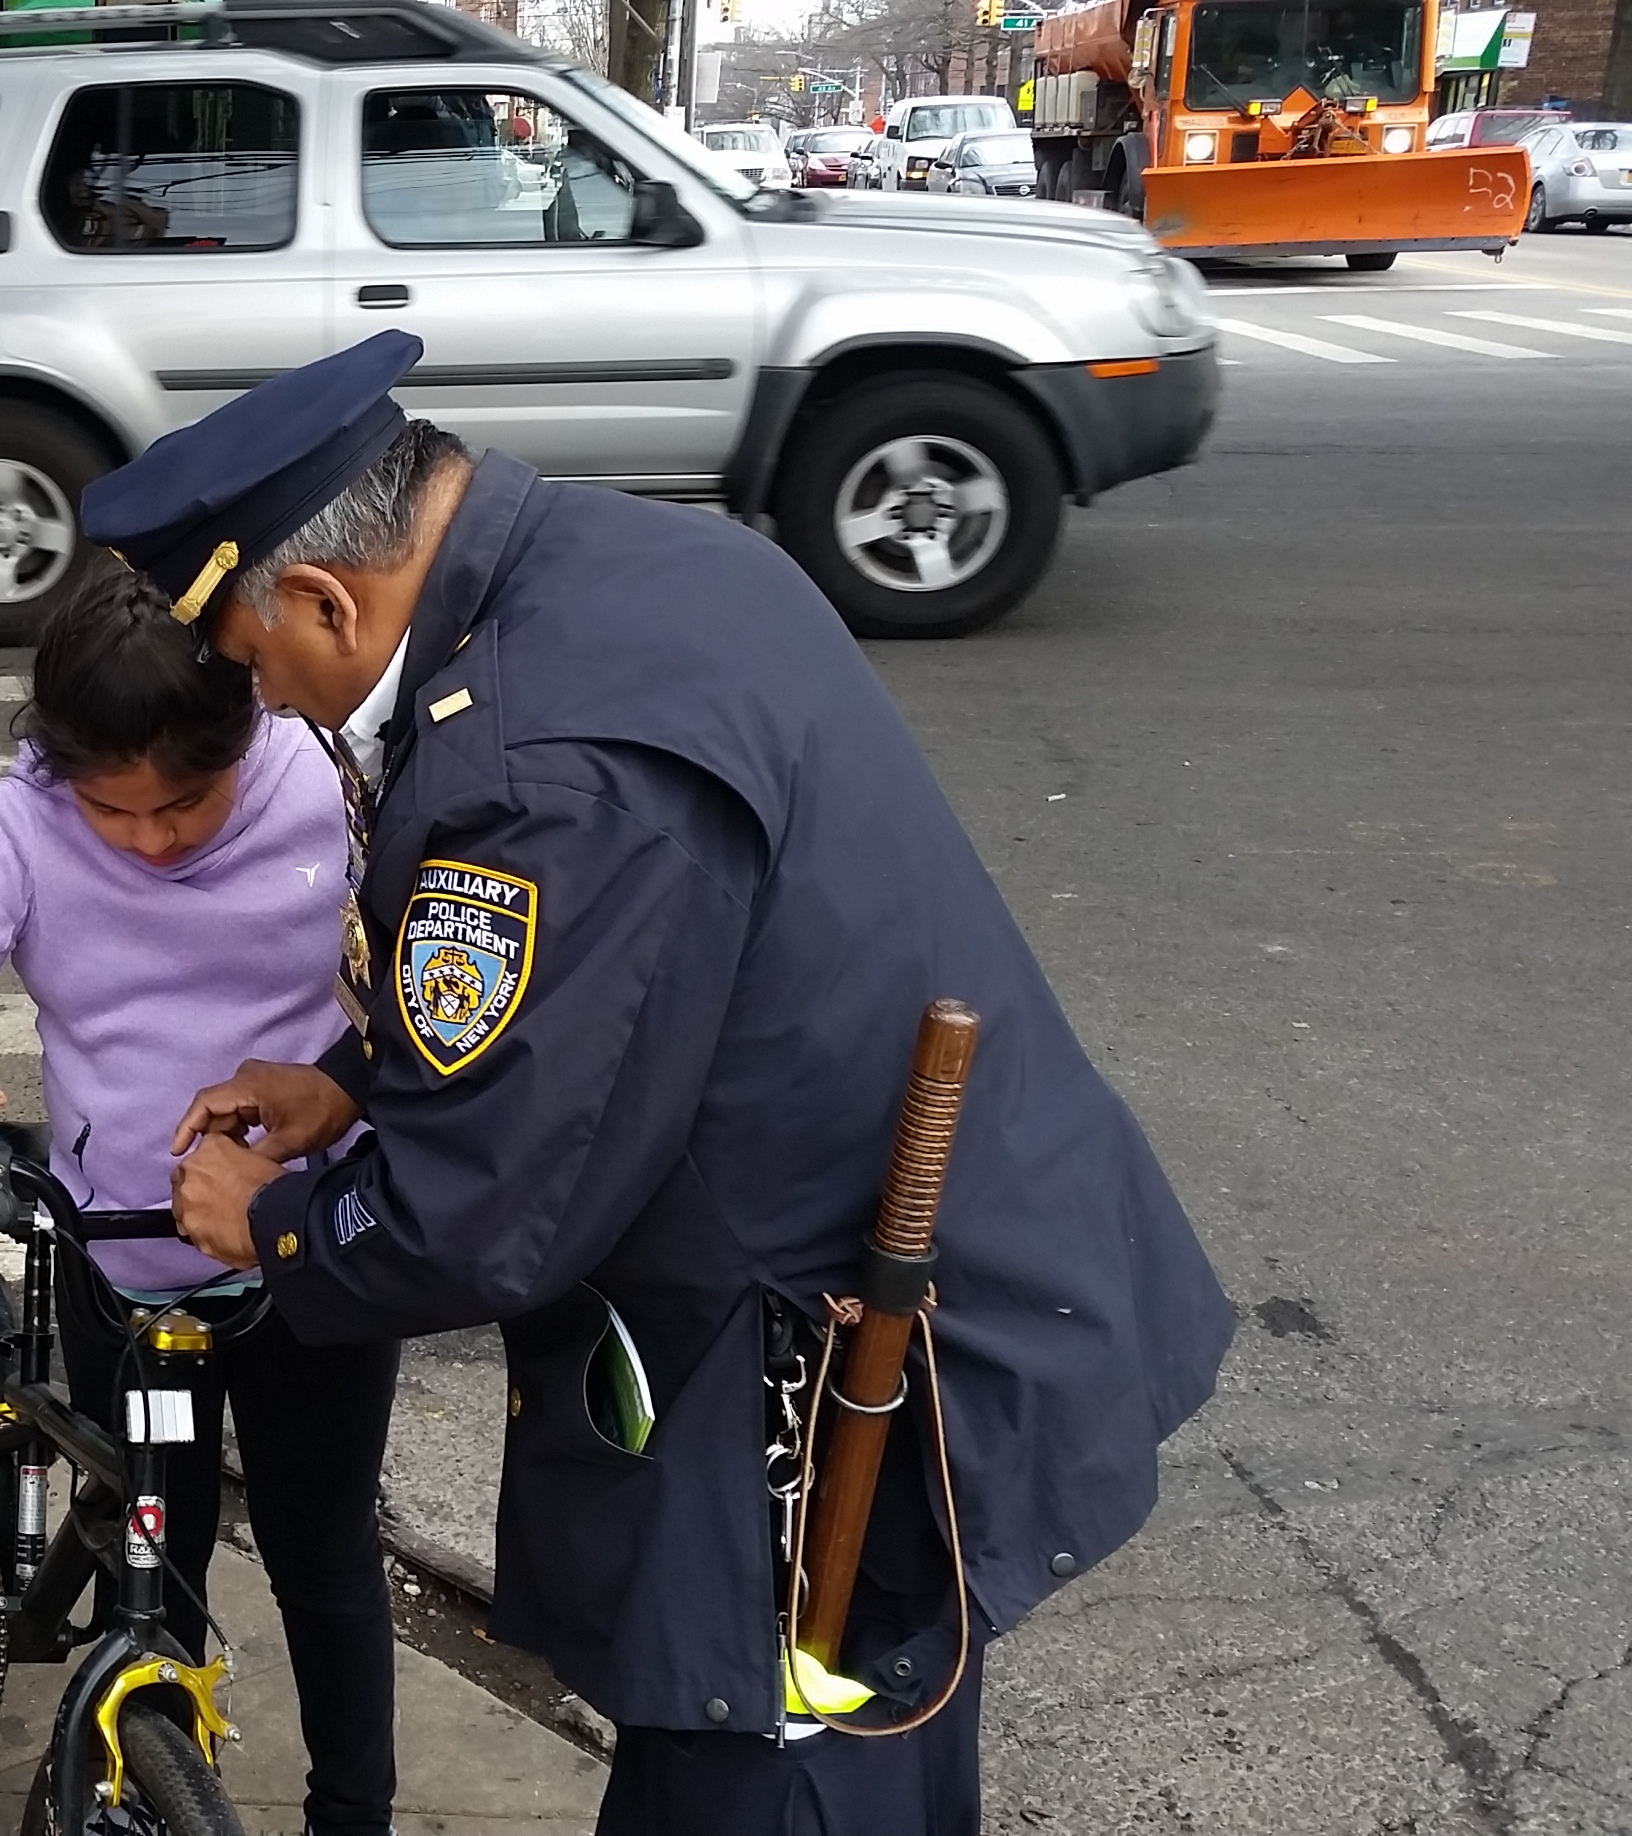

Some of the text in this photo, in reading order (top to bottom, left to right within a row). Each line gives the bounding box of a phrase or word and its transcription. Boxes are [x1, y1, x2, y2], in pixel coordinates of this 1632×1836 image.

[1015, 19, 1028, 28] 41
[1467, 167, 1516, 211] 52
[419, 869, 521, 906] AUXILIARY
[428, 901, 493, 930] POLICE
[407, 921, 521, 960] DEPARTMENT
[402, 964, 419, 1009] CITY
[414, 1014, 435, 1040] OF
[456, 1020, 490, 1053] NEW
[490, 971, 519, 1019] YORK
